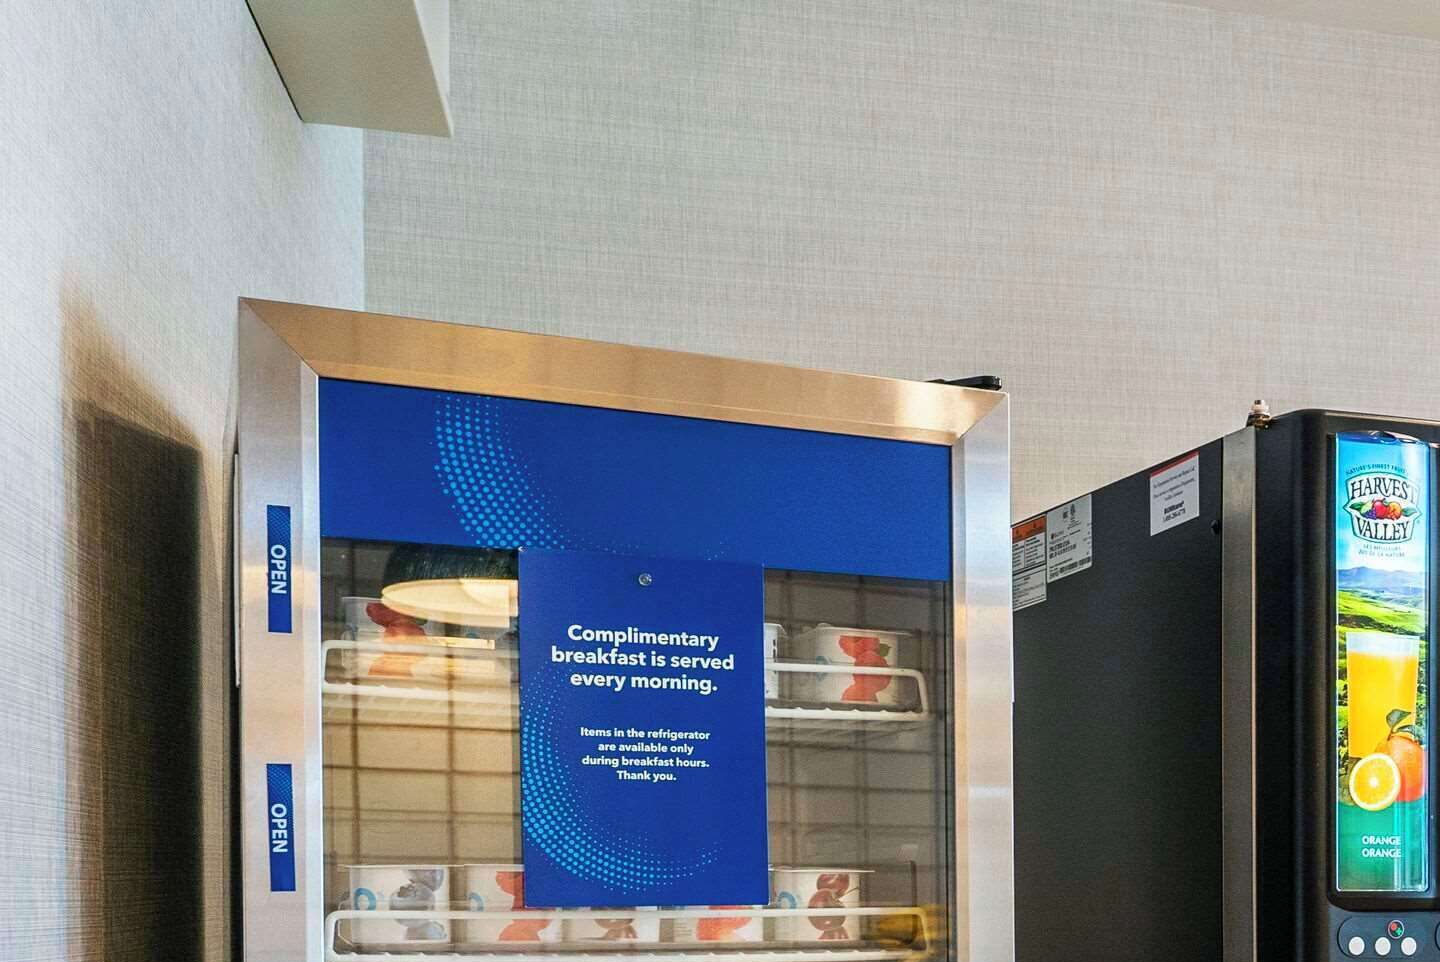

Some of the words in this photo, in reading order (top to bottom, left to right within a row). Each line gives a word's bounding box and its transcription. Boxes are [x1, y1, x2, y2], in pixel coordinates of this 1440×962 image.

[1350, 477, 1418, 504] HARVEST
[1354, 514, 1410, 541] VALLEY
[270, 544, 287, 595] OPEN
[567, 624, 719, 652] Complimentary
[551, 645, 647, 667] breakfast
[650, 651, 667, 668] is
[670, 653, 735, 671] served
[570, 673, 626, 692] every
[631, 674, 718, 695] morning.
[580, 727, 612, 737] Items
[614, 727, 625, 737] in
[626, 728, 645, 738] the
[647, 728, 711, 741] refrigerator
[598, 743, 616, 752] are
[618, 742, 668, 753] available
[670, 743, 694, 756] only
[581, 755, 619, 768] during
[621, 755, 674, 767] breakfast
[676, 757, 710, 768] hours.
[616, 770, 651, 780] Thank
[653, 773, 677, 783] you.
[271, 803, 288, 854] OPEN
[1361, 836, 1401, 846] ORANGE
[1361, 848, 1402, 858] ORANGE
